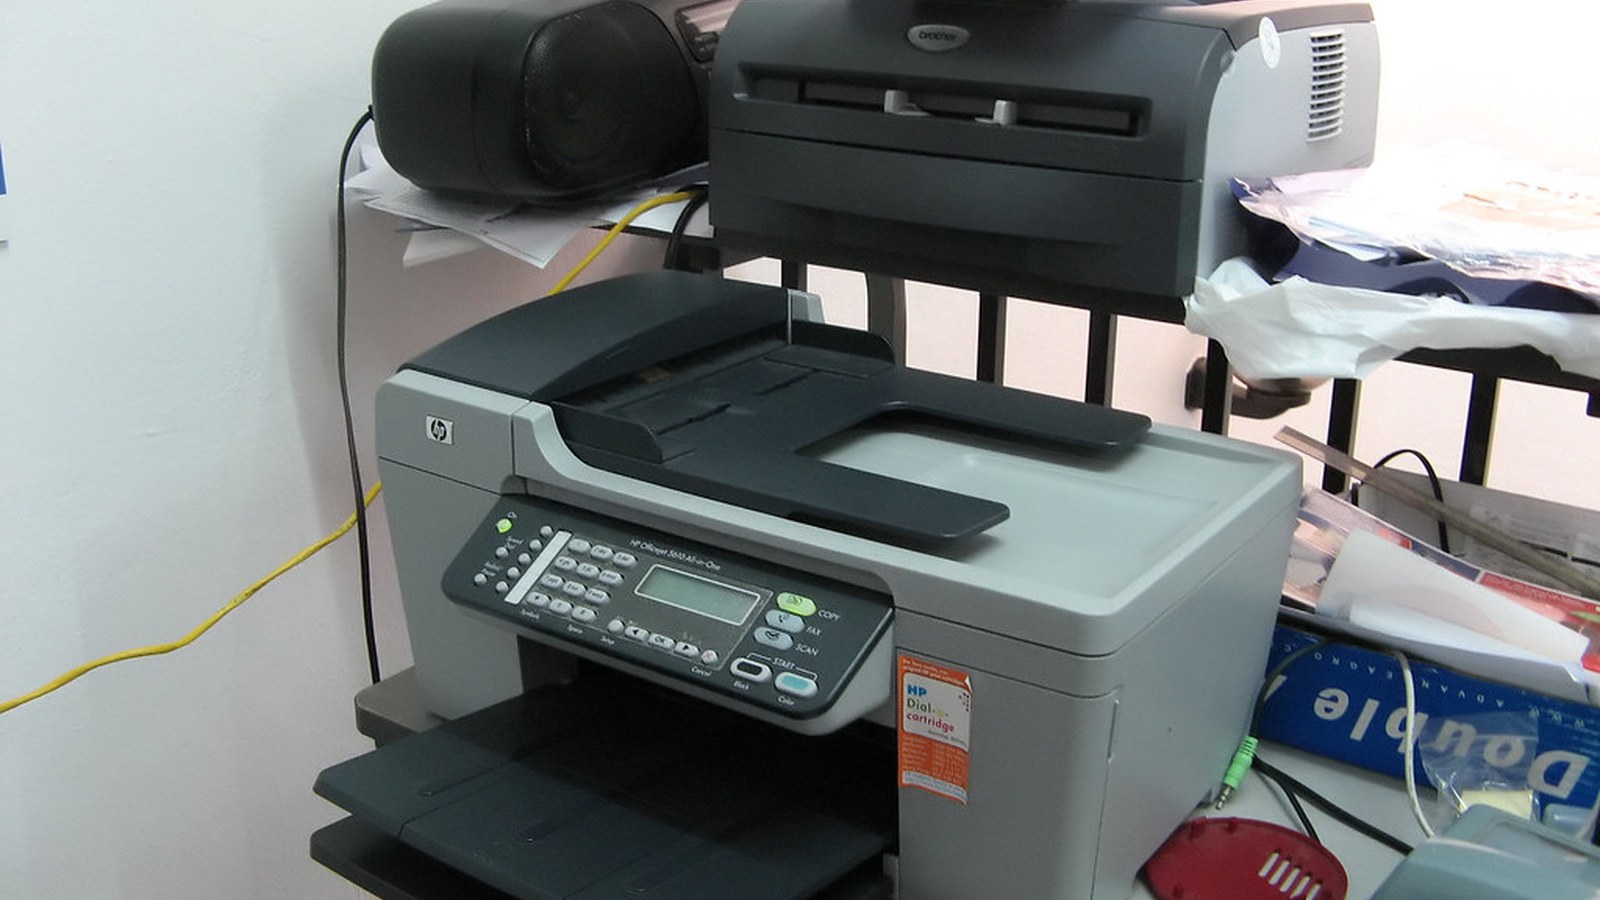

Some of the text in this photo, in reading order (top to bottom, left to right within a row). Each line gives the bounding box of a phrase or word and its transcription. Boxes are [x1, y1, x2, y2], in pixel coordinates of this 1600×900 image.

[818, 609, 840, 621] COPY
[807, 626, 822, 637] FAX
[795, 643, 819, 657] SCAN
[772, 657, 796, 670] START
[907, 684, 927, 697] HP
[907, 713, 955, 733] cartridge
